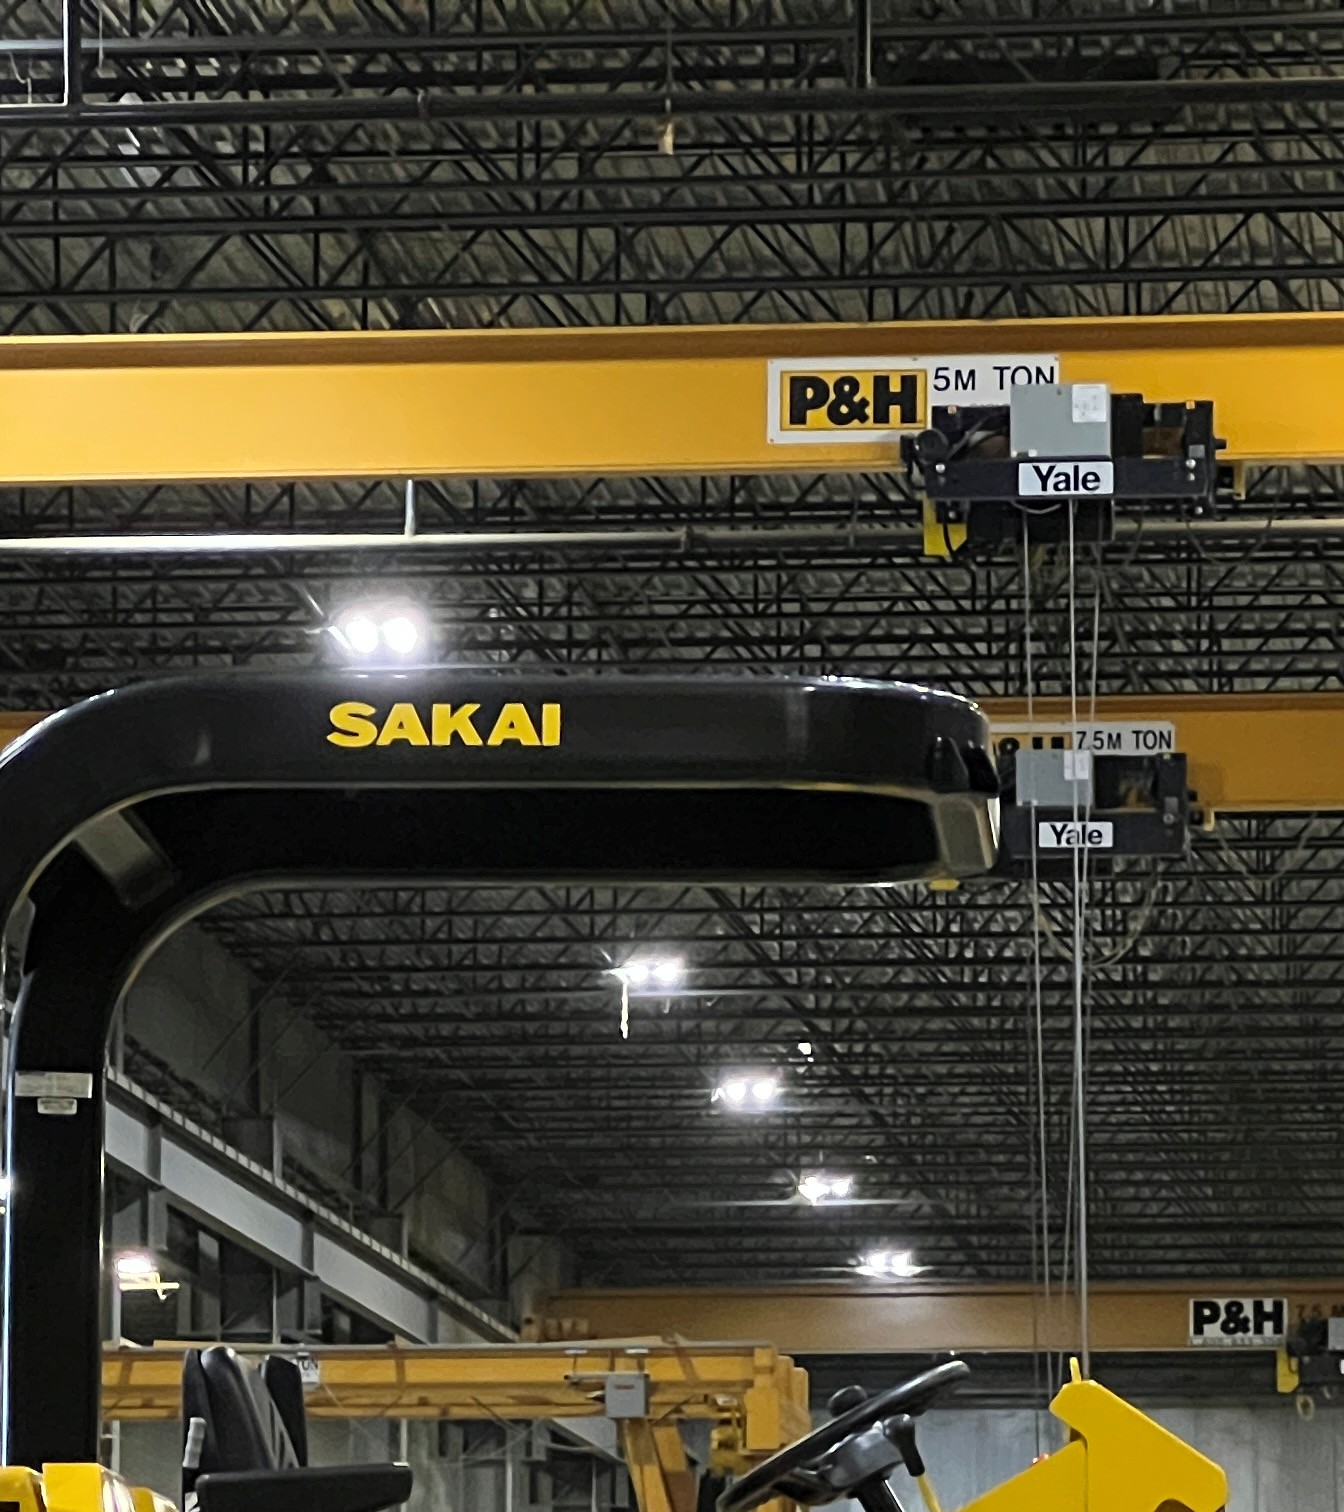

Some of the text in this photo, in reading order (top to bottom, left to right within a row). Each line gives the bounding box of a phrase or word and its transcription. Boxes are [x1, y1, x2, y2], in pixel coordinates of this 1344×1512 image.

[933, 365, 1055, 391] 5M TON
[789, 374, 918, 426] P&H
[1032, 464, 1102, 492] Yale
[326, 701, 561, 747] SAKAI
[1132, 729, 1172, 750] TON
[1049, 822, 1103, 846] Yale
[1193, 1300, 1284, 1335] P&H
